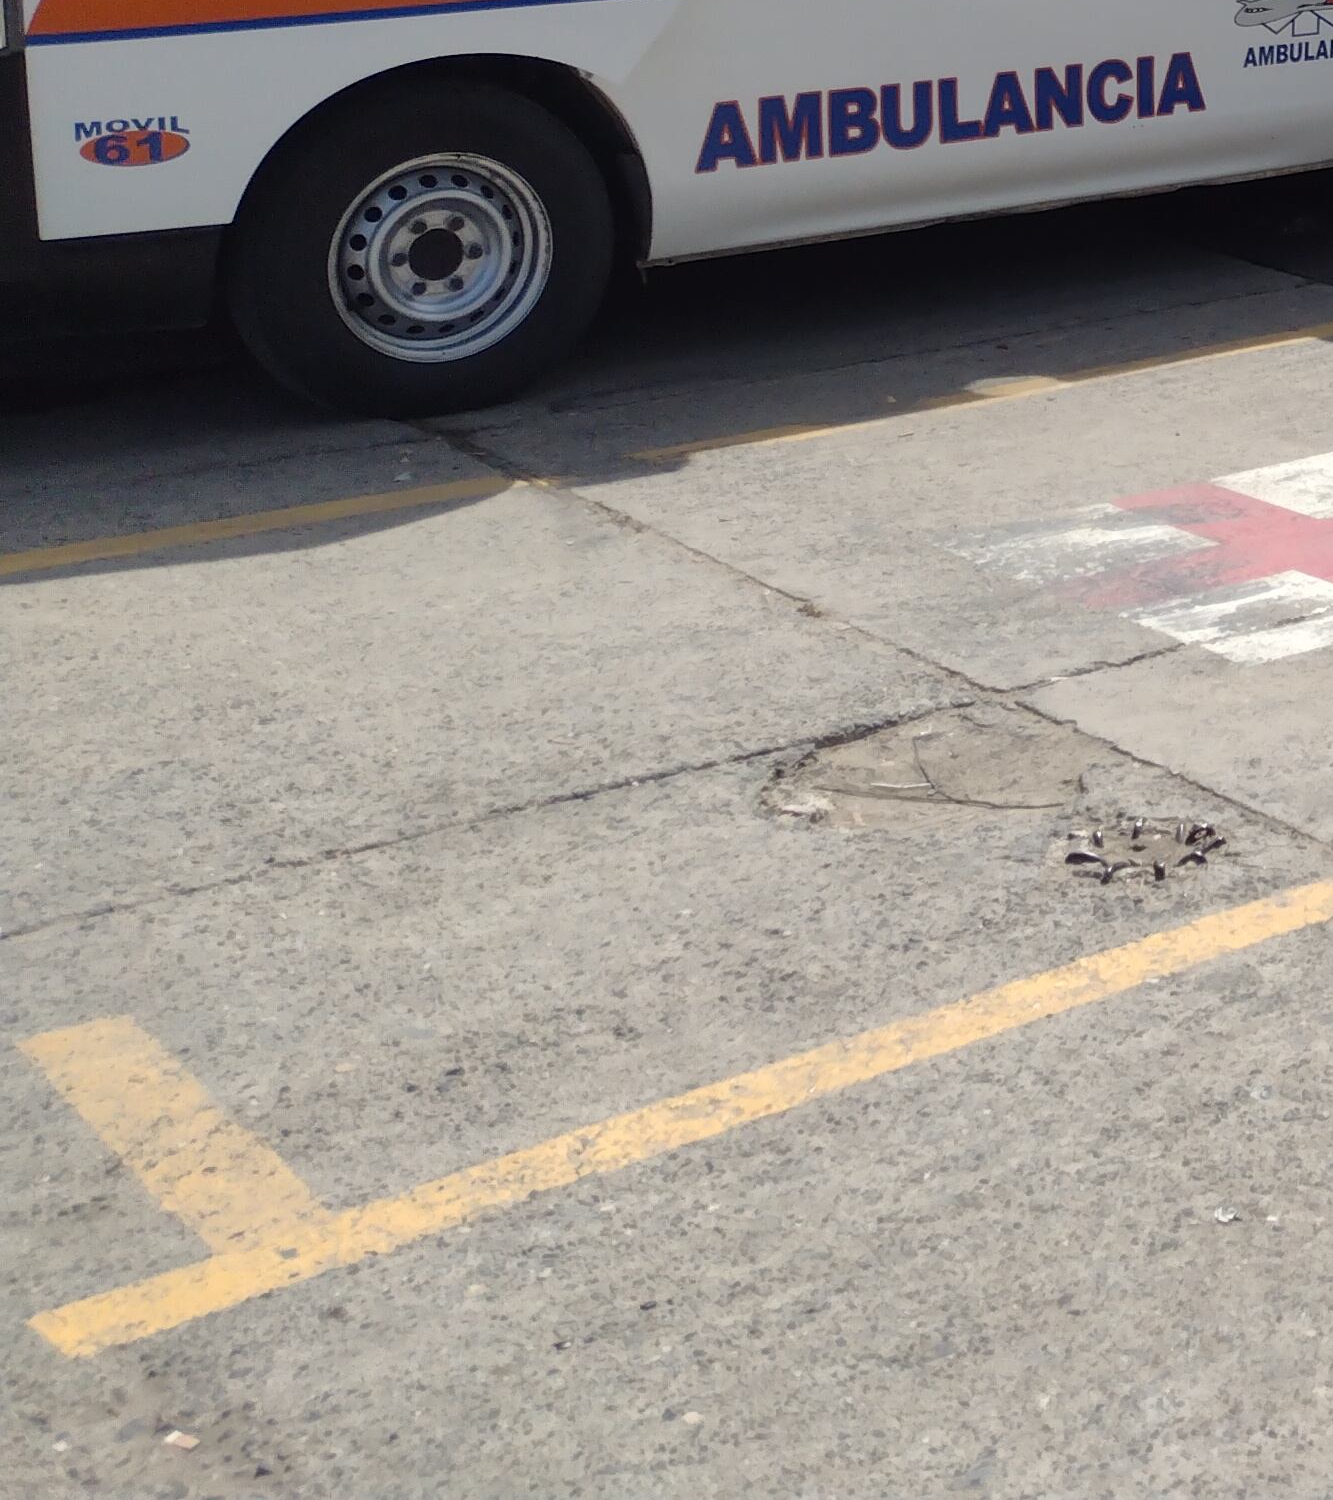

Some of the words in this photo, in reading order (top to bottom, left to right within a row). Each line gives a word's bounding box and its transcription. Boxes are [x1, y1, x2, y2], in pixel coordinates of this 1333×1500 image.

[74, 116, 190, 142] MOVIL
[695, 52, 1206, 174] AMBULANCIA
[95, 130, 163, 166] 61
